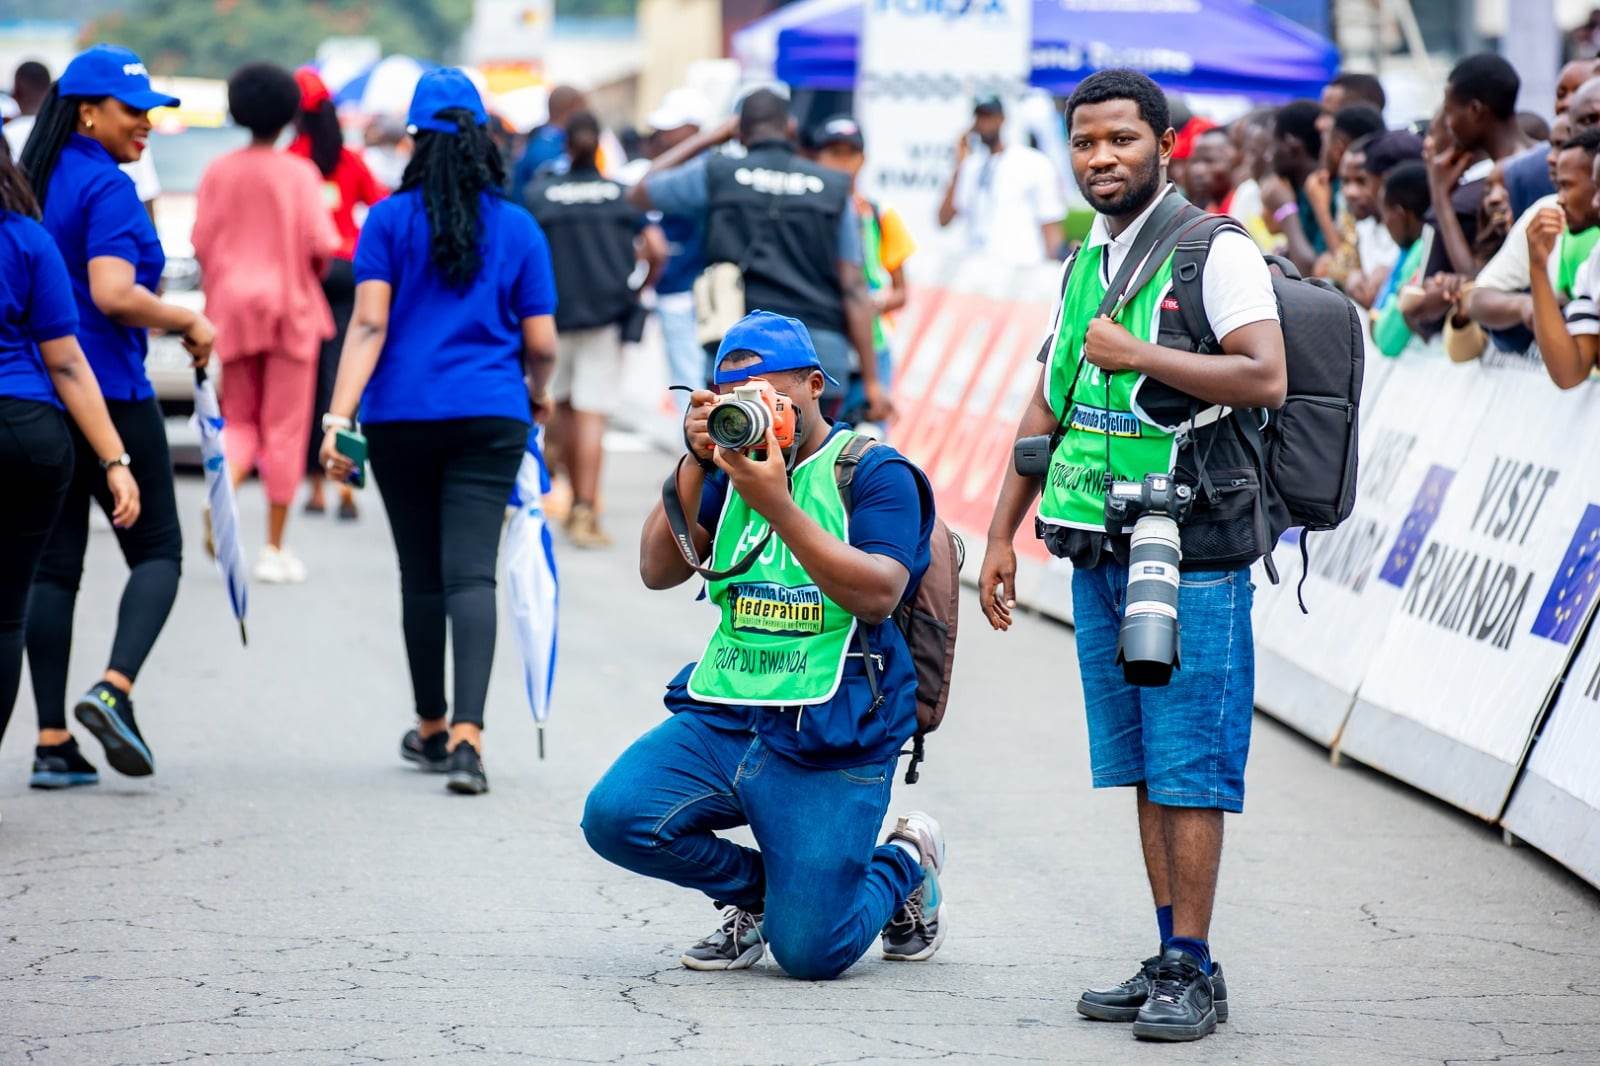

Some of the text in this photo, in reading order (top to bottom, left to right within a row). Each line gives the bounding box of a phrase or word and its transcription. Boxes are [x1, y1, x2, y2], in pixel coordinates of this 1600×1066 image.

[1100, 412, 1137, 434] Cycling
[1470, 456, 1560, 545] VISIT
[779, 586, 820, 605] Cycling
[1401, 542, 1534, 650] RWANDA
[712, 647, 808, 674] TOUR DU RWANDA
